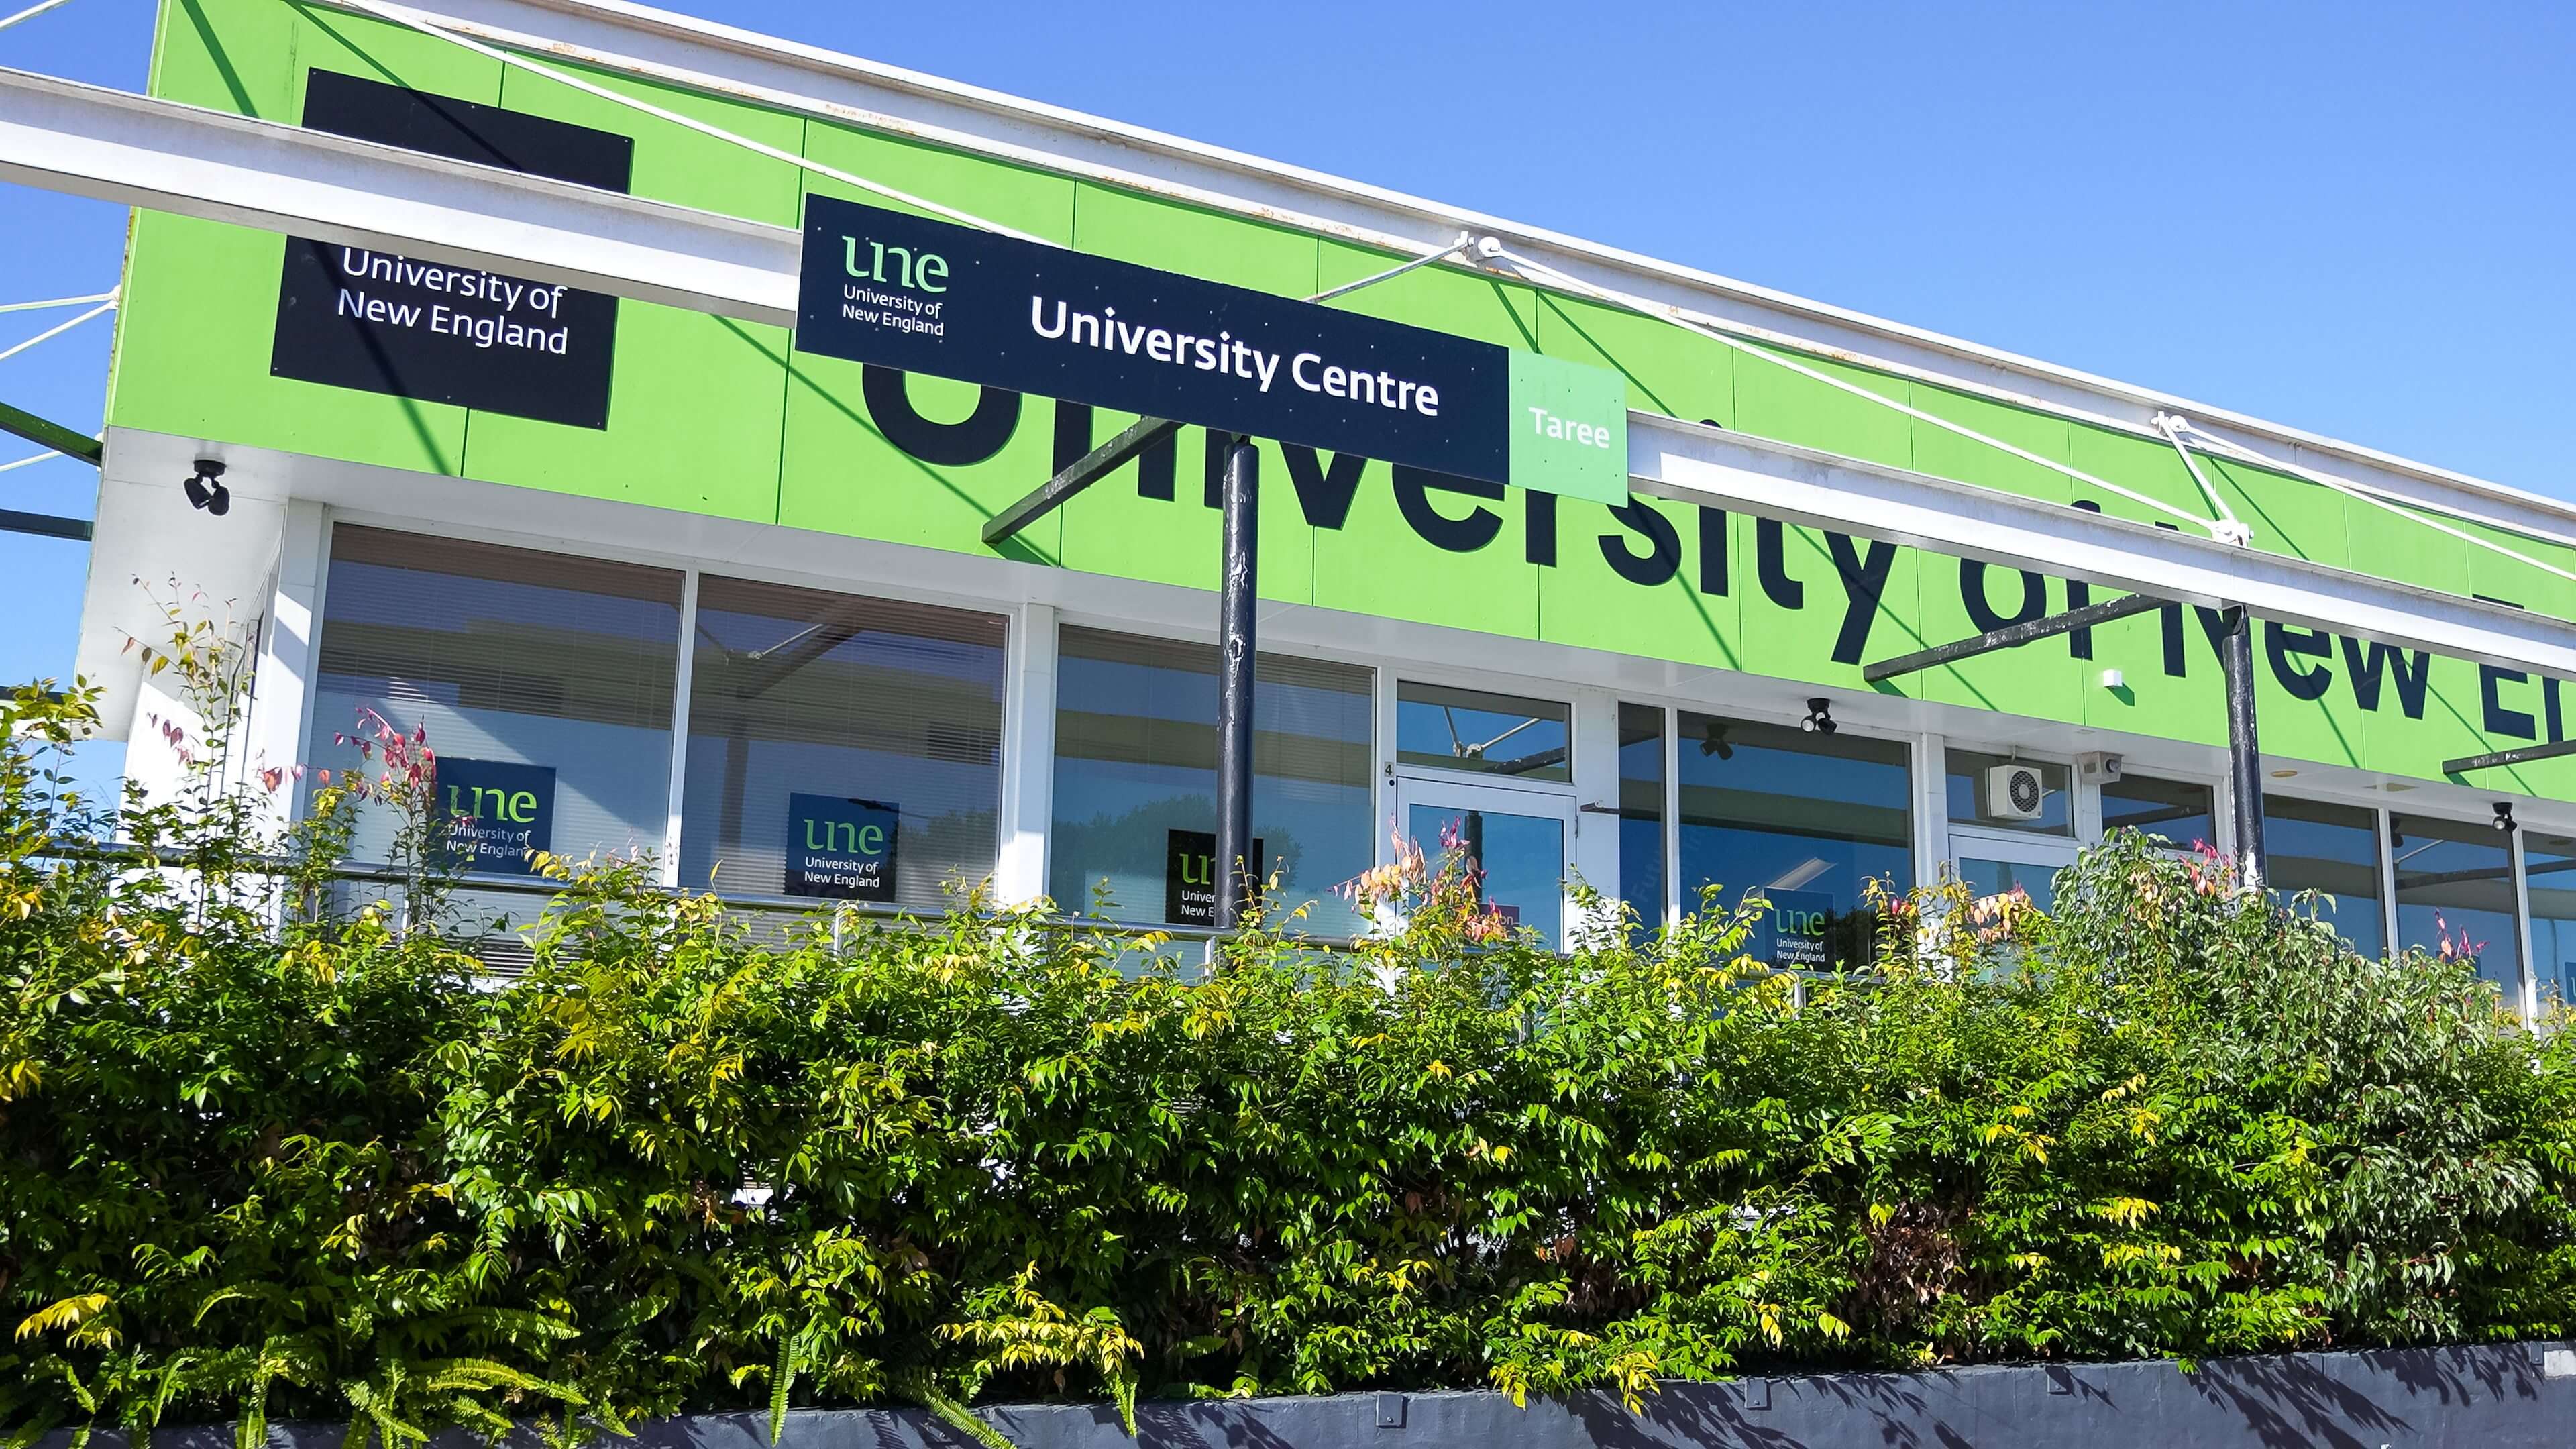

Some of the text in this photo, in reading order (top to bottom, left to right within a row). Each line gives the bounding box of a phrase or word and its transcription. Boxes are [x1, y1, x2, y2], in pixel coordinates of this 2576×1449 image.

[842, 235, 949, 293] une
[343, 247, 568, 319] University of
[844, 284, 943, 319] University of
[338, 288, 568, 355] New England
[843, 304, 945, 337] New England
[1031, 296, 1440, 417] University Centre
[1528, 407, 1610, 449] Taree
[1385, 764, 1393, 775] 4
[447, 784, 537, 823] une
[517, 830, 531, 844] of
[804, 819, 883, 855] une
[805, 857, 879, 875] University of
[805, 871, 880, 888] New England
[1181, 904, 1206, 916] New
[1182, 890, 1216, 902] Univer
[1775, 909, 1825, 936] une
[1776, 938, 1823, 952] University of
[1776, 950, 1825, 963] New England
